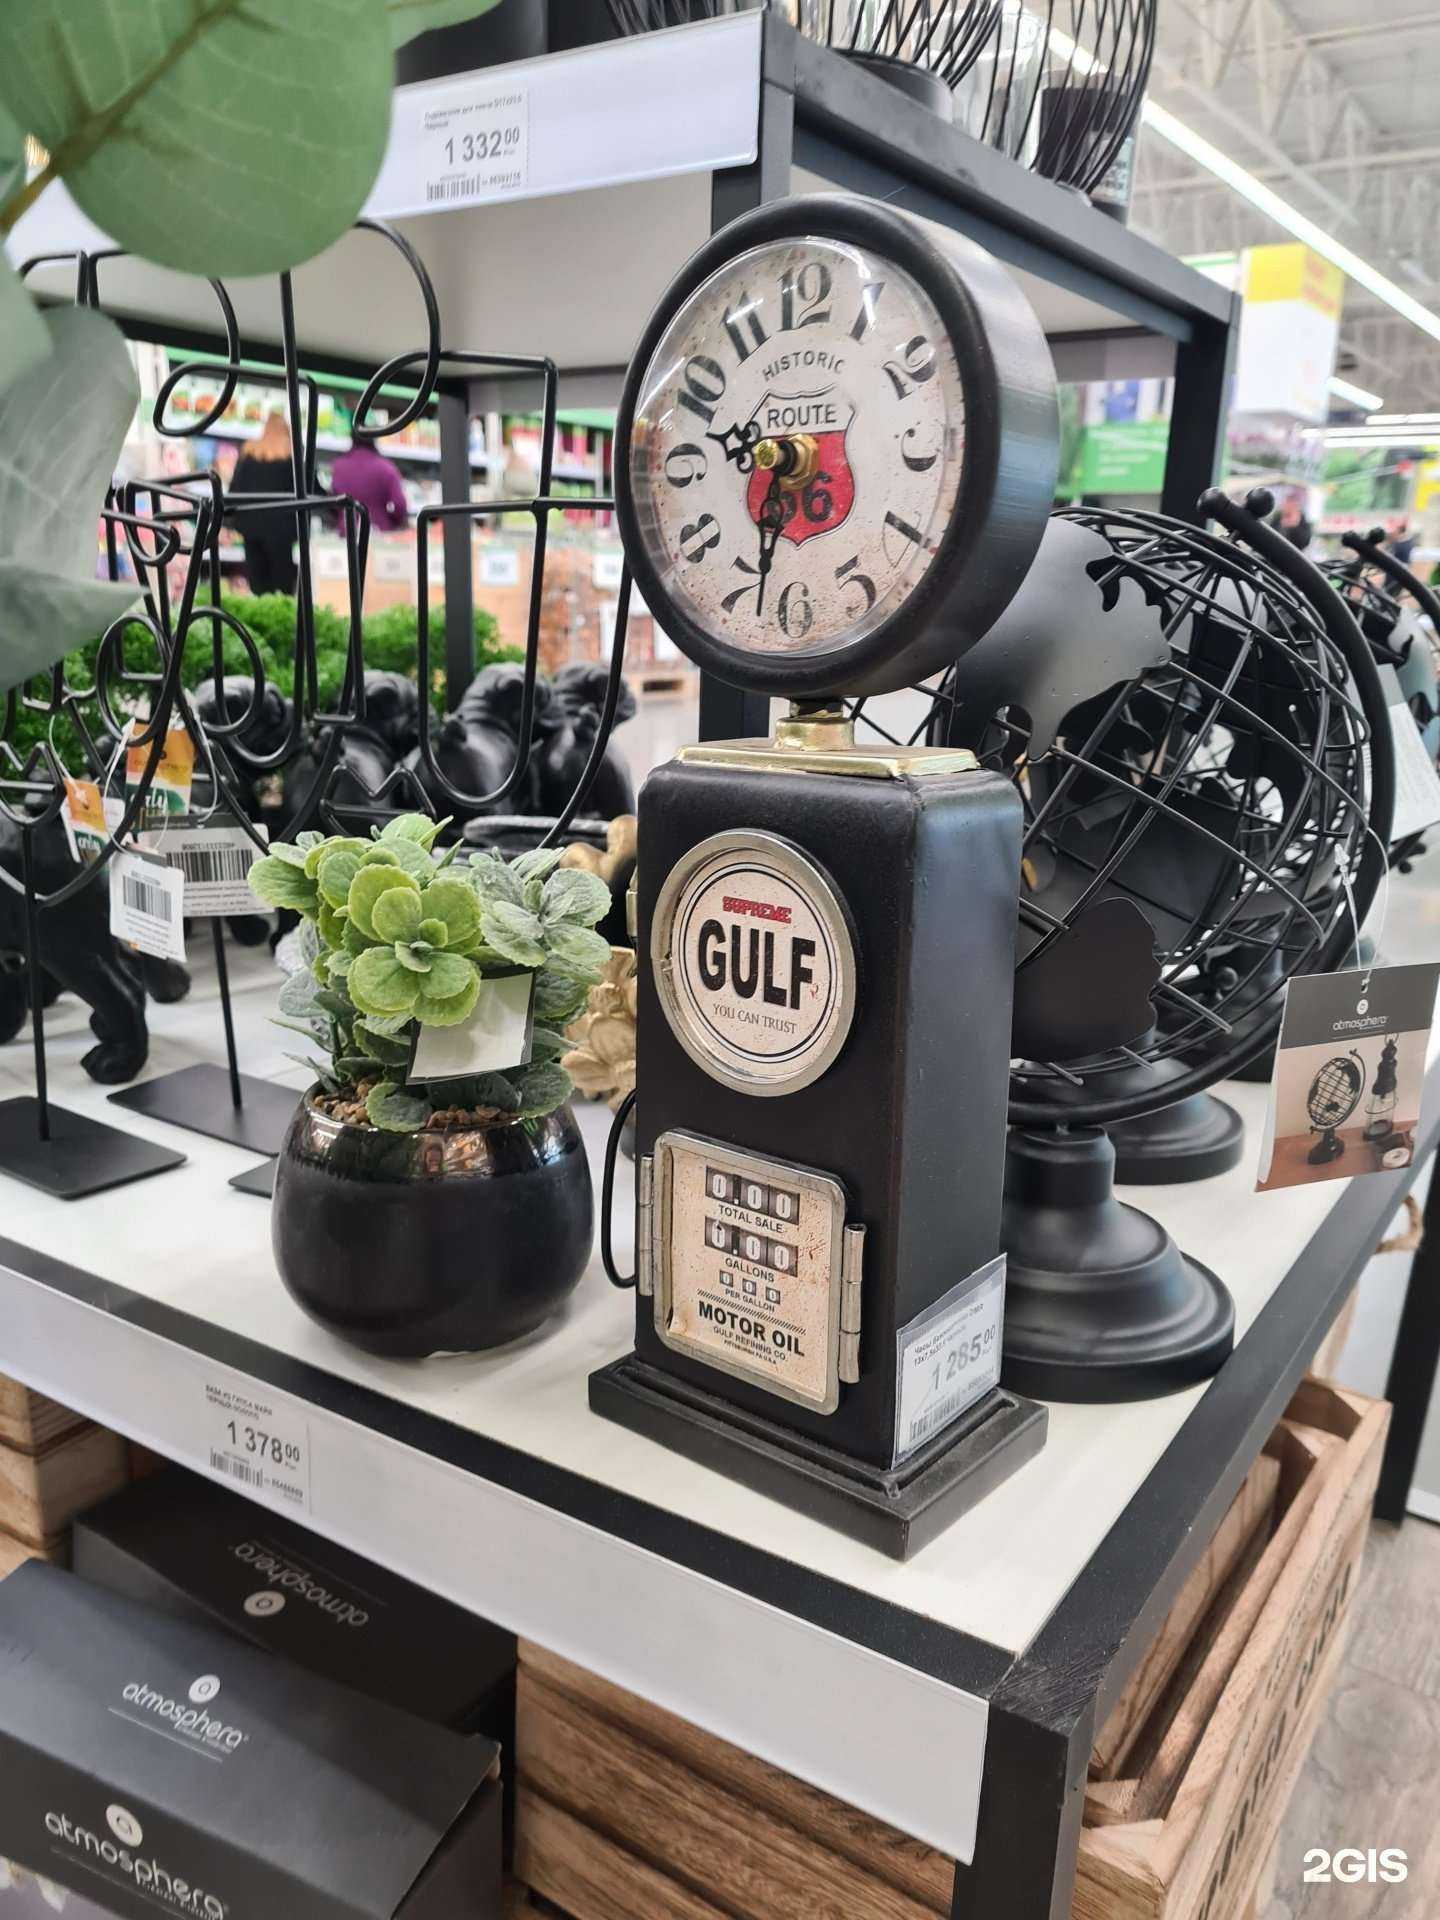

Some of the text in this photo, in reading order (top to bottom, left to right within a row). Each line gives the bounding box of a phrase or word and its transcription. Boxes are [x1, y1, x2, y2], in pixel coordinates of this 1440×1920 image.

[775, 262, 832, 332] 12
[676, 354, 728, 428] 10
[762, 350, 844, 382] HISTORIC
[767, 403, 837, 429] ROUTE
[679, 513, 721, 564] 8
[777, 581, 813, 639] 6
[834, 555, 877, 619] 5
[699, 918, 816, 1011] GULF
[713, 1003, 798, 1034] YOU CAN TRUST
[719, 1204, 784, 1234] TOTAL SALE
[725, 1257, 775, 1282] GALLONS
[699, 1300, 766, 1342] MOTOR
[772, 1330, 805, 1357] OIL
[713, 1326, 734, 1338] GULF
[122, 1683, 242, 1750] atmosphera
[45, 1812, 223, 1920] atmosphera
